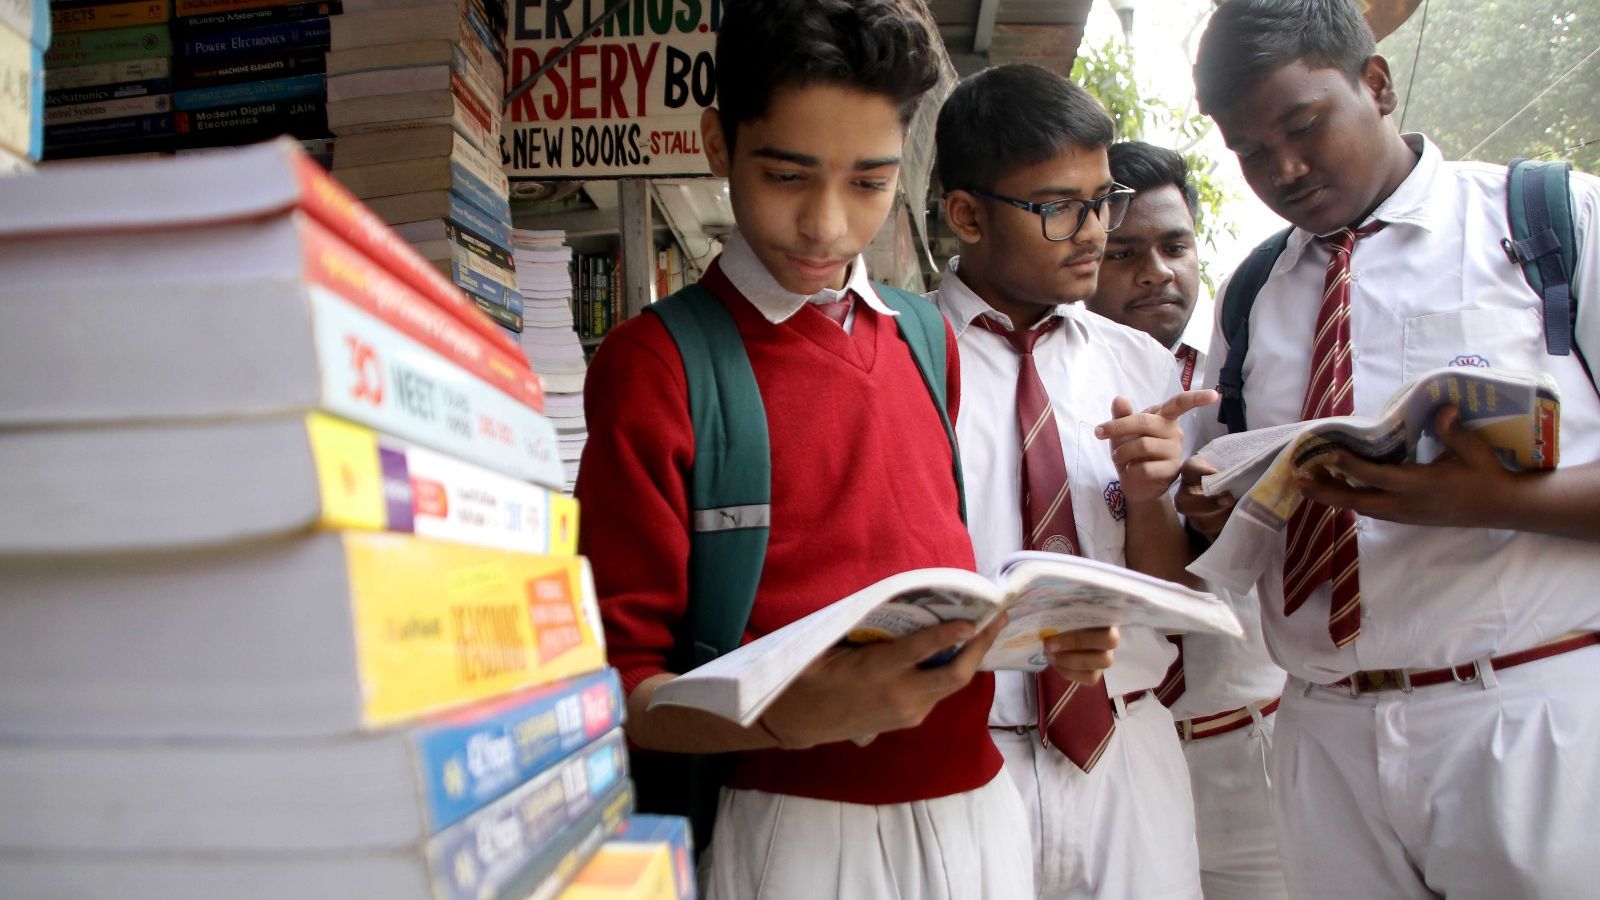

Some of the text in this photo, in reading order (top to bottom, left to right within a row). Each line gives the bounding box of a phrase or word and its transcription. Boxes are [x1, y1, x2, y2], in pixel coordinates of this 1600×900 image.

[189, 16, 225, 26] Building
[218, 66, 249, 75] MACHINE
[250, 61, 285, 71] ELEMENTS
[502, 41, 660, 121] RSERY
[73, 105, 106, 117] Systems
[195, 103, 276, 122] Modern Digital
[289, 103, 316, 115] JAIN
[197, 117, 258, 131] Electronics
[513, 127, 564, 169] NEW
[571, 123, 650, 168] BOOKS.
[650, 130, 700, 155] STALL
